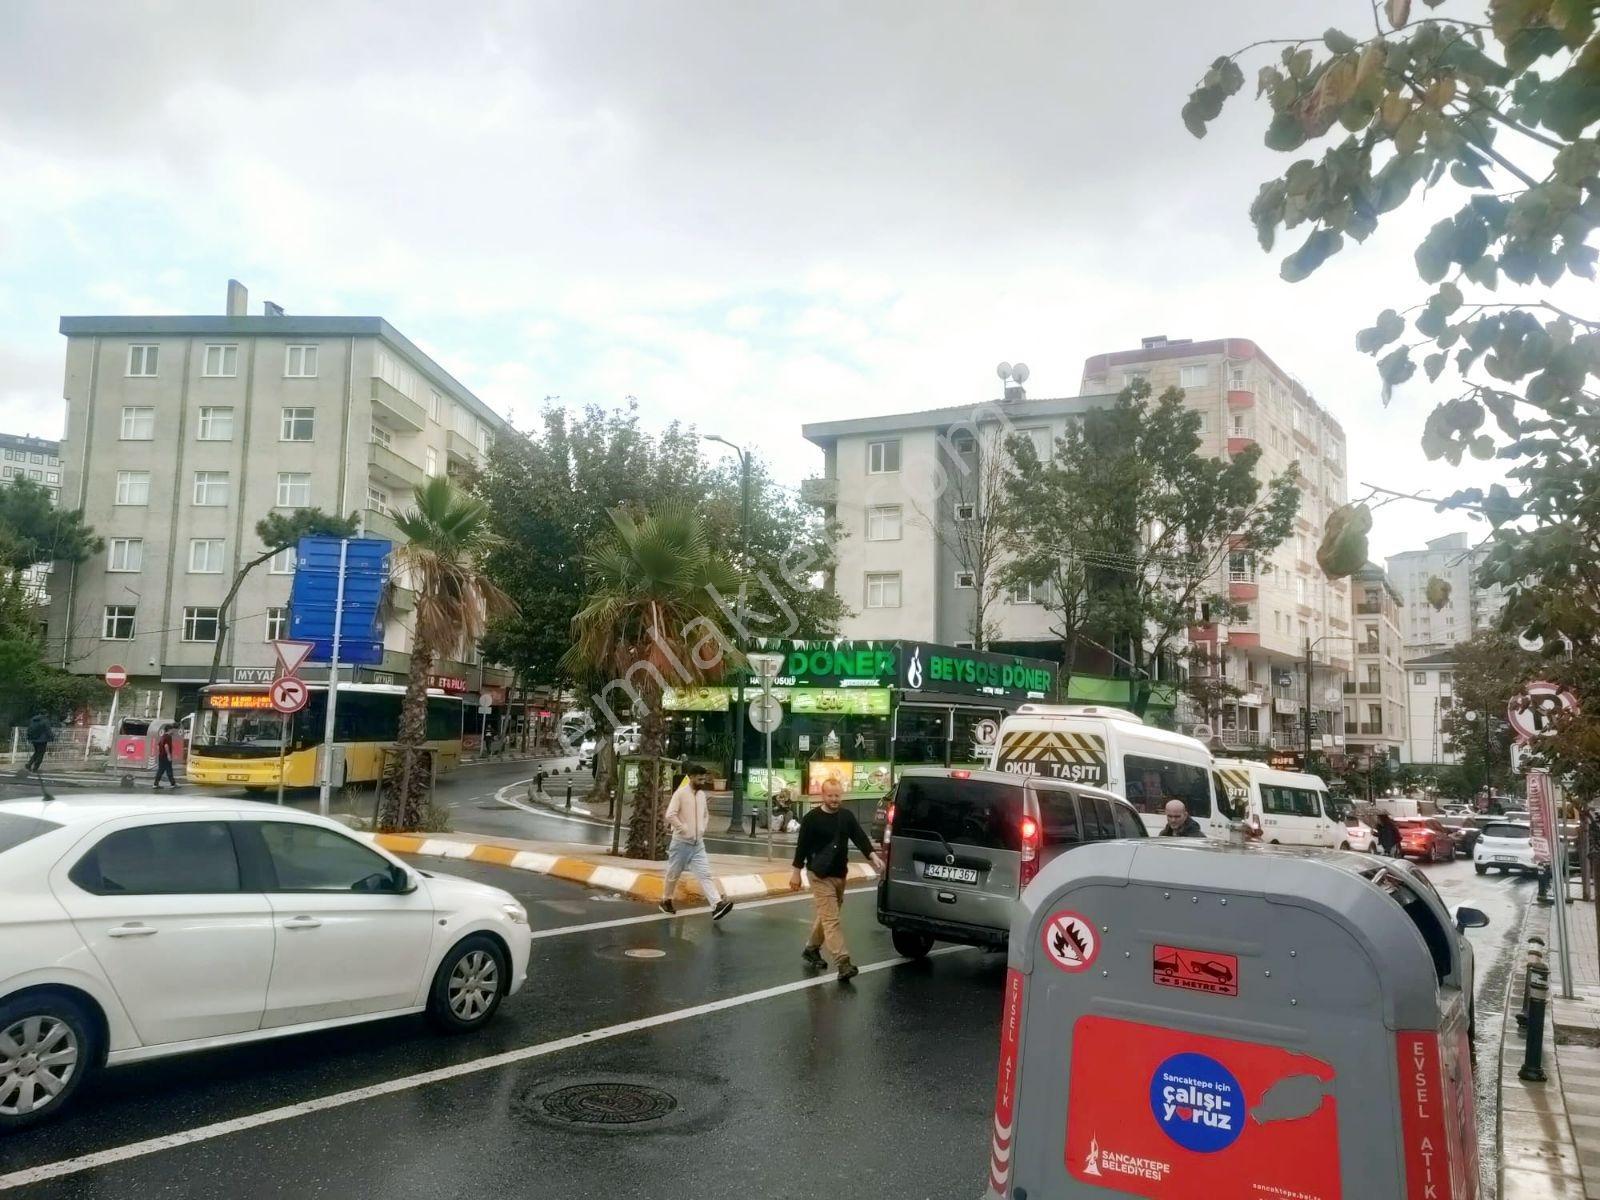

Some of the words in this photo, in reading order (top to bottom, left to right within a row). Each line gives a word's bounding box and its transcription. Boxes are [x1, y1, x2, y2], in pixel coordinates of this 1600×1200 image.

[238, 671, 255, 681] MY
[256, 671, 276, 681] YAP
[930, 655, 998, 686] BEYSOS
[1002, 658, 1050, 692] DÖNER
[1004, 761, 1041, 776] OKUL
[1051, 763, 1101, 783] TAŞITI
[929, 865, 940, 875] 34
[942, 867, 957, 879] FYT
[959, 869, 976, 880] 367
[1182, 981, 1216, 990] METRE
[1009, 978, 1018, 1042] EVSEL
[1002, 1055, 1011, 1107] ATIK
[1163, 1072, 1213, 1089] Sancaktepe
[1215, 1081, 1231, 1092] için
[1413, 1041, 1430, 1118] EVSEL
[1163, 1085, 1231, 1111] çalışı-
[1102, 1150, 1170, 1173] SANCAKTEPE
[1102, 1160, 1162, 1181] BELEDİYESİ
[1420, 1137, 1438, 1200] ATIK
